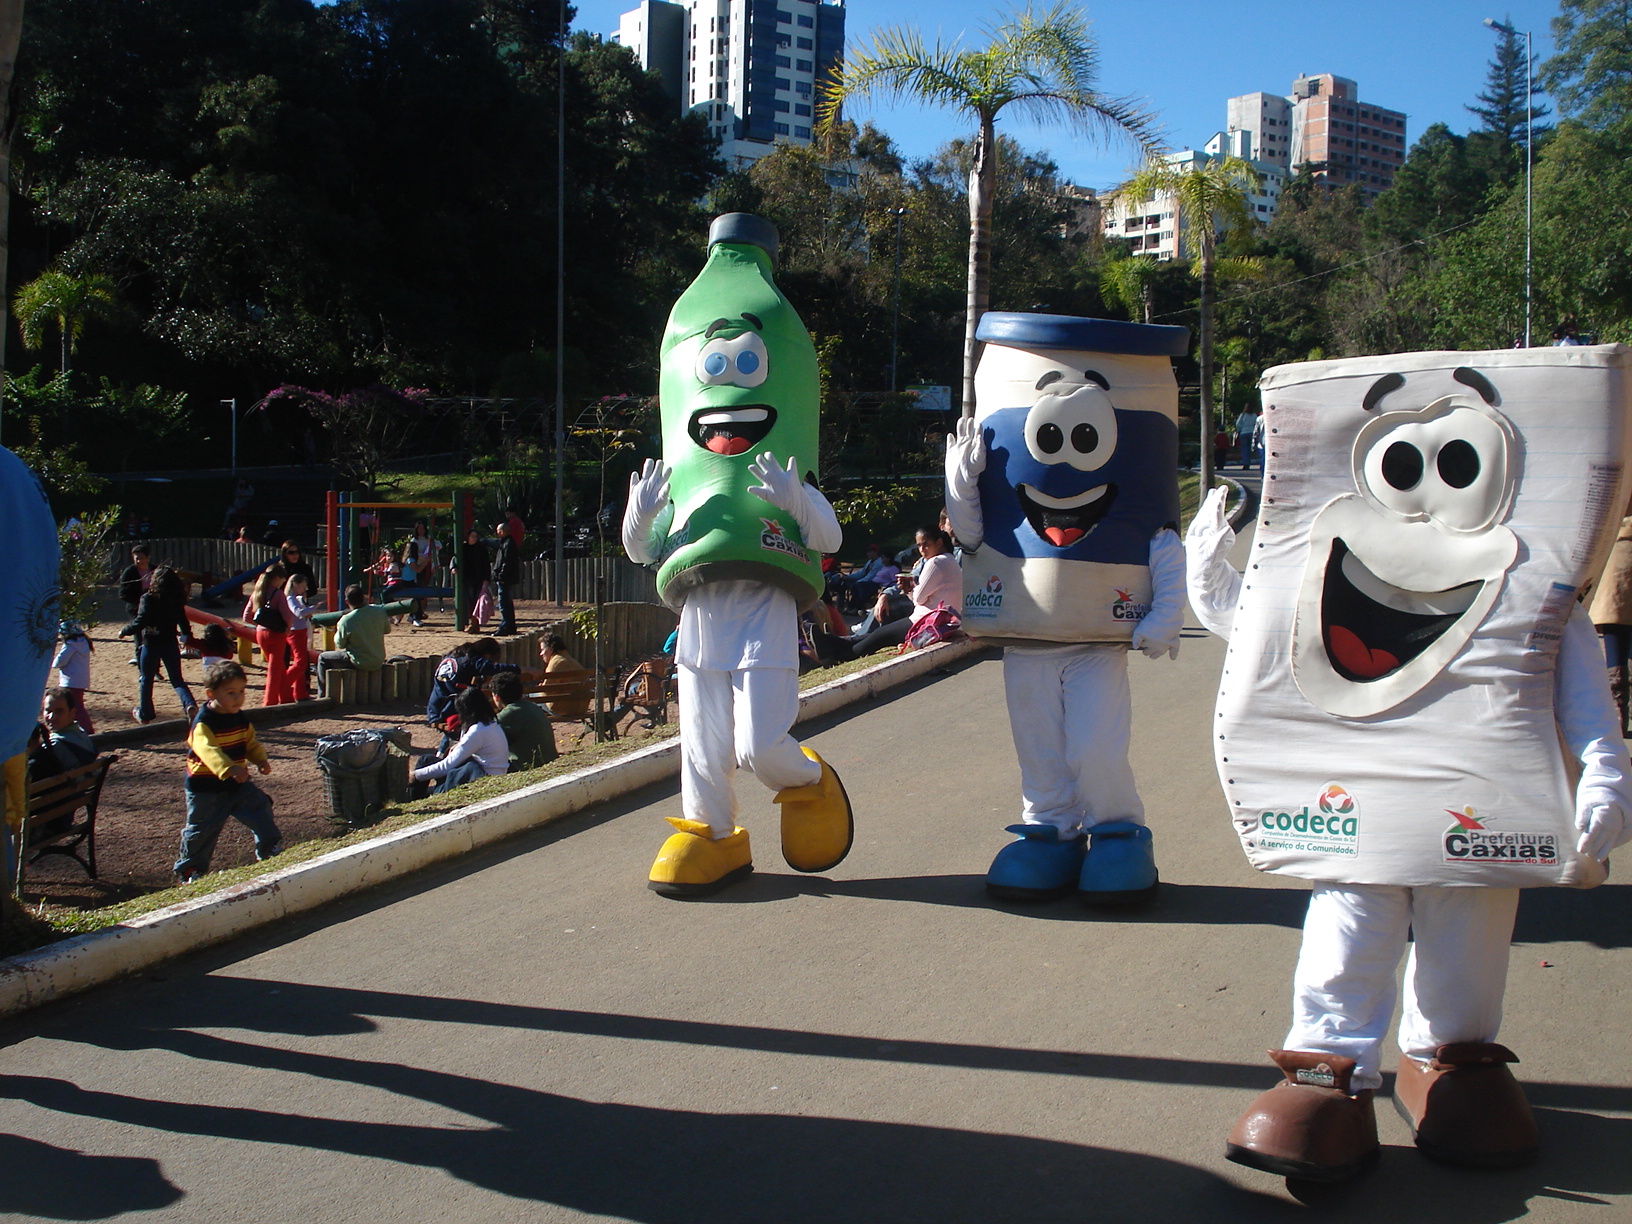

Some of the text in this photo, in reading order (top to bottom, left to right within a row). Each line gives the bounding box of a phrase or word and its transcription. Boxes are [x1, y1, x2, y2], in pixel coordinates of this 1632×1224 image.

[965, 589, 1003, 607] codeca
[1261, 806, 1357, 836] codeca
[1260, 839, 1356, 855] A serviço da Comunidade.
[1445, 834, 1556, 858] Caxias
[1470, 832, 1555, 845] Prefeitura
